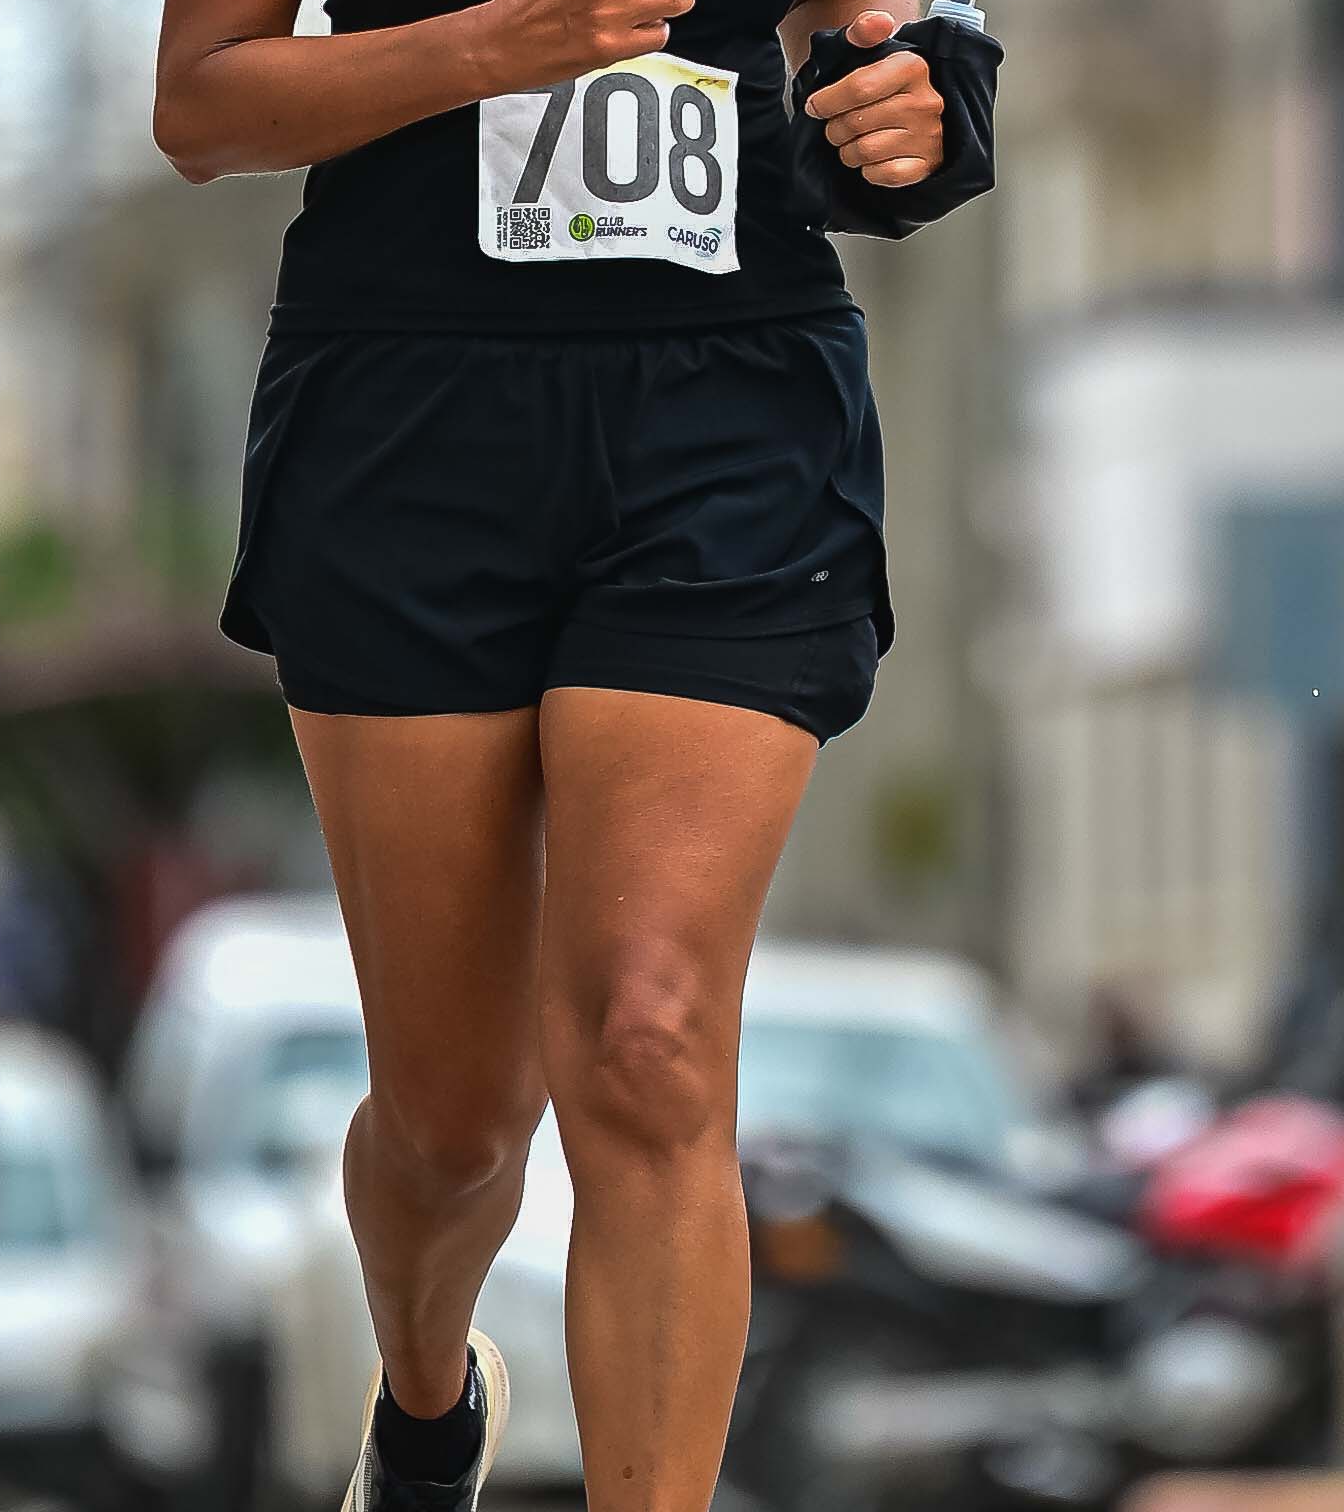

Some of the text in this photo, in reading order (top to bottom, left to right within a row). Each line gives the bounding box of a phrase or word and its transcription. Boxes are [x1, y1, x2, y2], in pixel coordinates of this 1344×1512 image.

[511, 72, 723, 216] 708
[596, 216, 624, 227] CLUB
[667, 226, 719, 255] CARUSO
